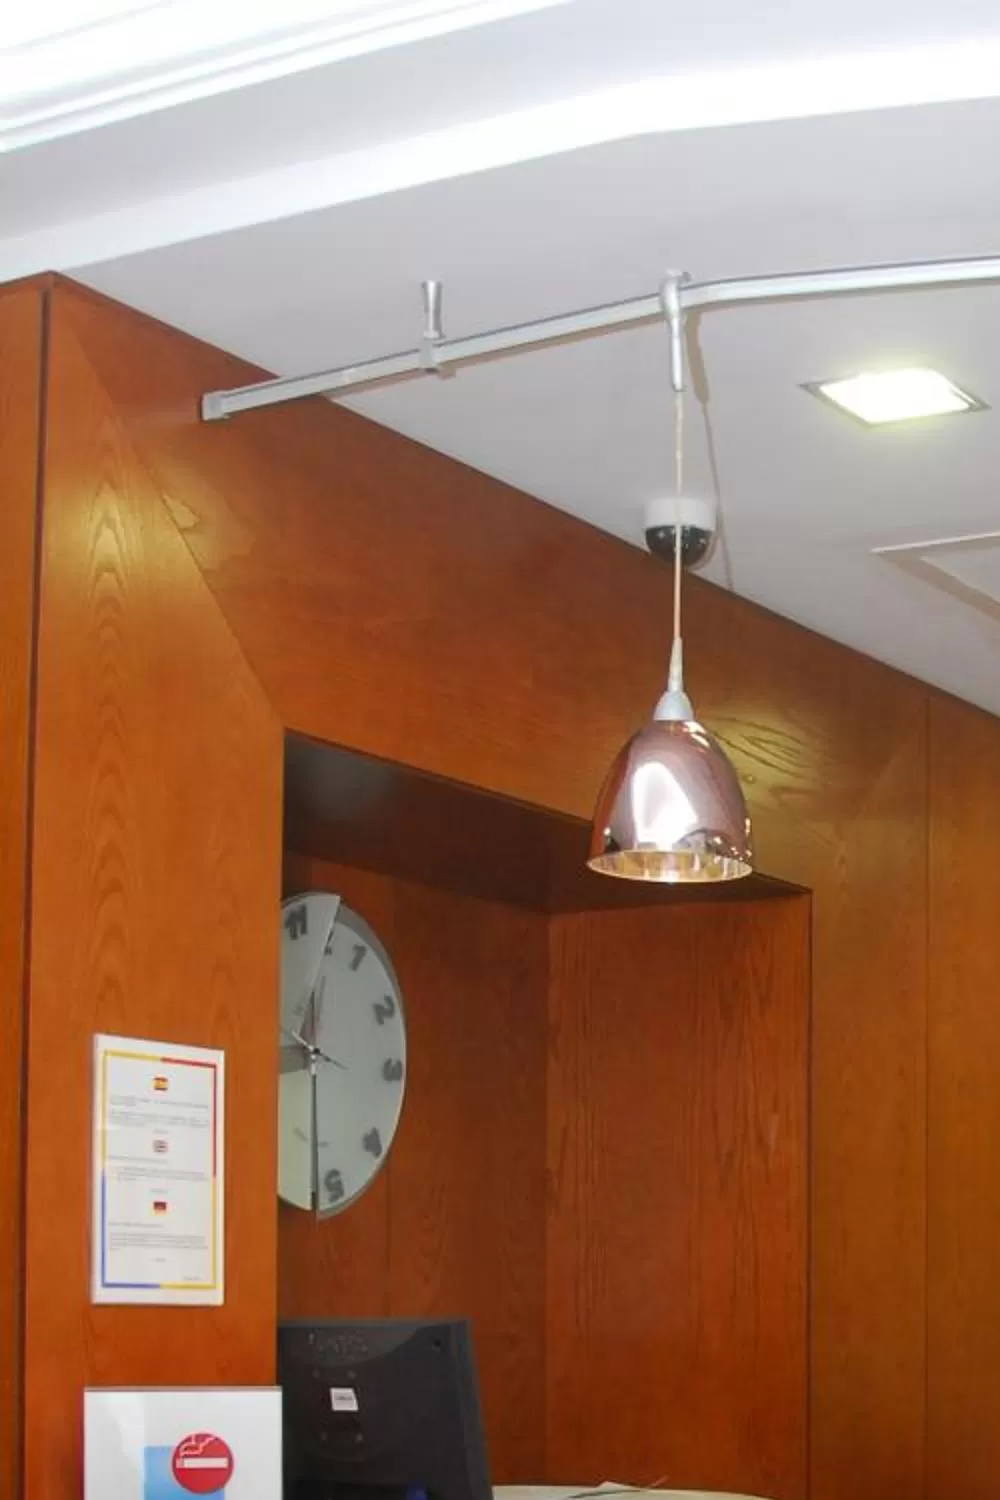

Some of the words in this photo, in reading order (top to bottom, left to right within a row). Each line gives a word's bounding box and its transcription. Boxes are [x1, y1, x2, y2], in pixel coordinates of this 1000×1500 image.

[351, 944, 367, 971] 1
[373, 995, 395, 1025] 2
[382, 1057, 403, 1082] 3
[362, 1127, 382, 1158] 4
[324, 1169, 345, 1202] 5
